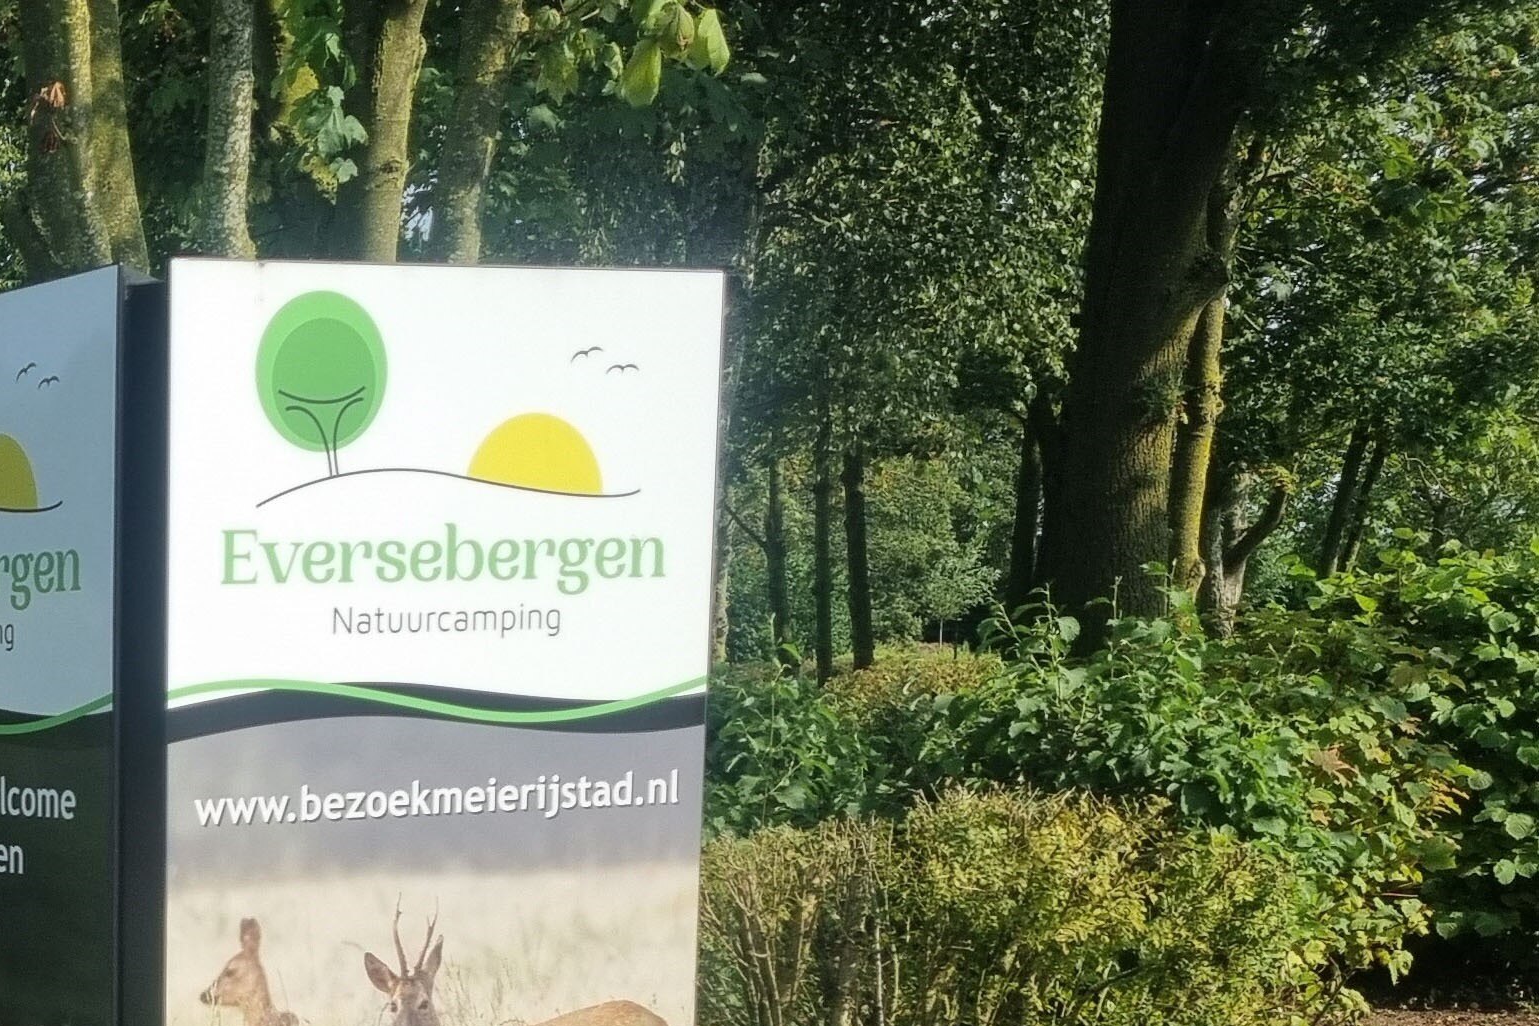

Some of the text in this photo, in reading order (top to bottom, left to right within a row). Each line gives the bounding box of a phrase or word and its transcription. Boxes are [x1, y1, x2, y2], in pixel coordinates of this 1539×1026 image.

[221, 523, 666, 596] Eversebergen
[332, 603, 562, 639] Natuurcamping
[195, 769, 680, 827] www.bezoekmeierijstad.nl
